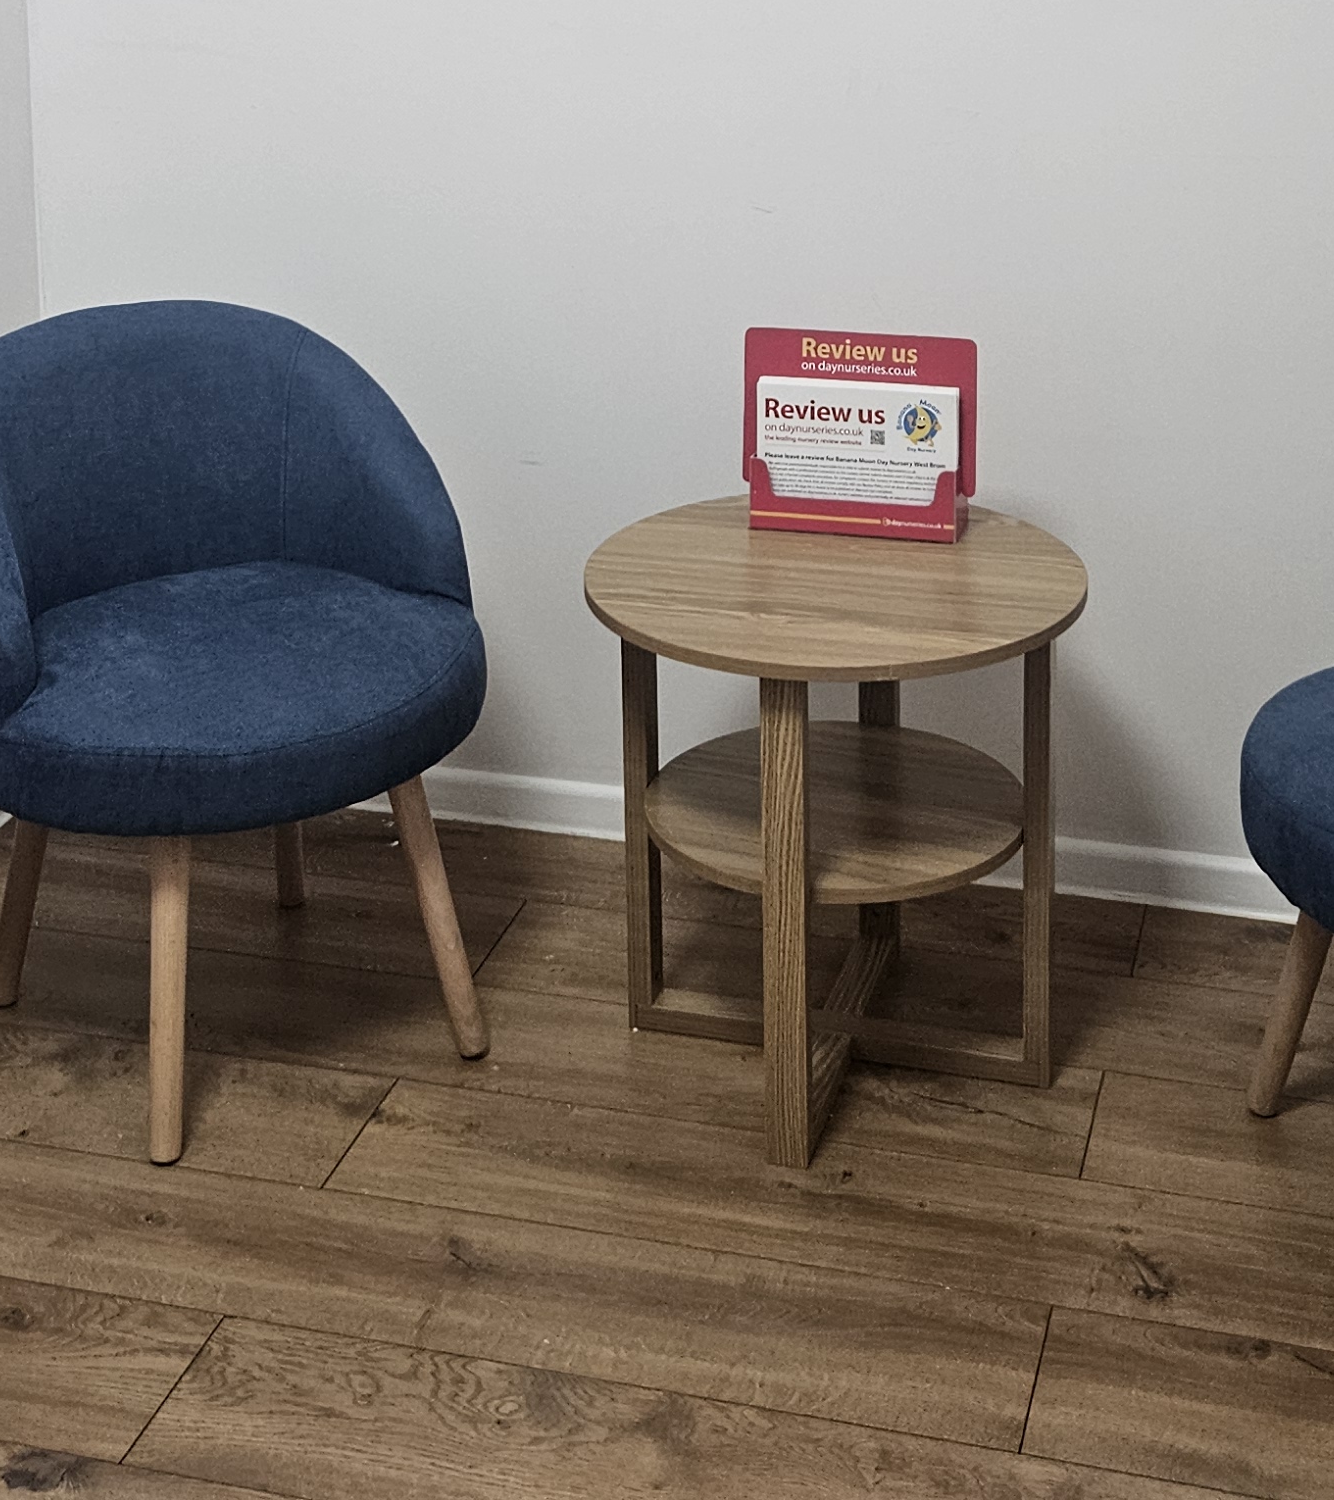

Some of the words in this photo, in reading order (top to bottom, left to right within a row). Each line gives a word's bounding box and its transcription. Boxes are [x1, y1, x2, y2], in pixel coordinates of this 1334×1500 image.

[801, 337, 885, 362] Review
[892, 346, 918, 364] us
[801, 361, 816, 371] on
[817, 360, 918, 377] daynurseries.co.uk
[765, 398, 851, 422] Review
[858, 408, 885, 424] us
[765, 423, 777, 431] on
[779, 423, 864, 436] daynurseries.co.uk
